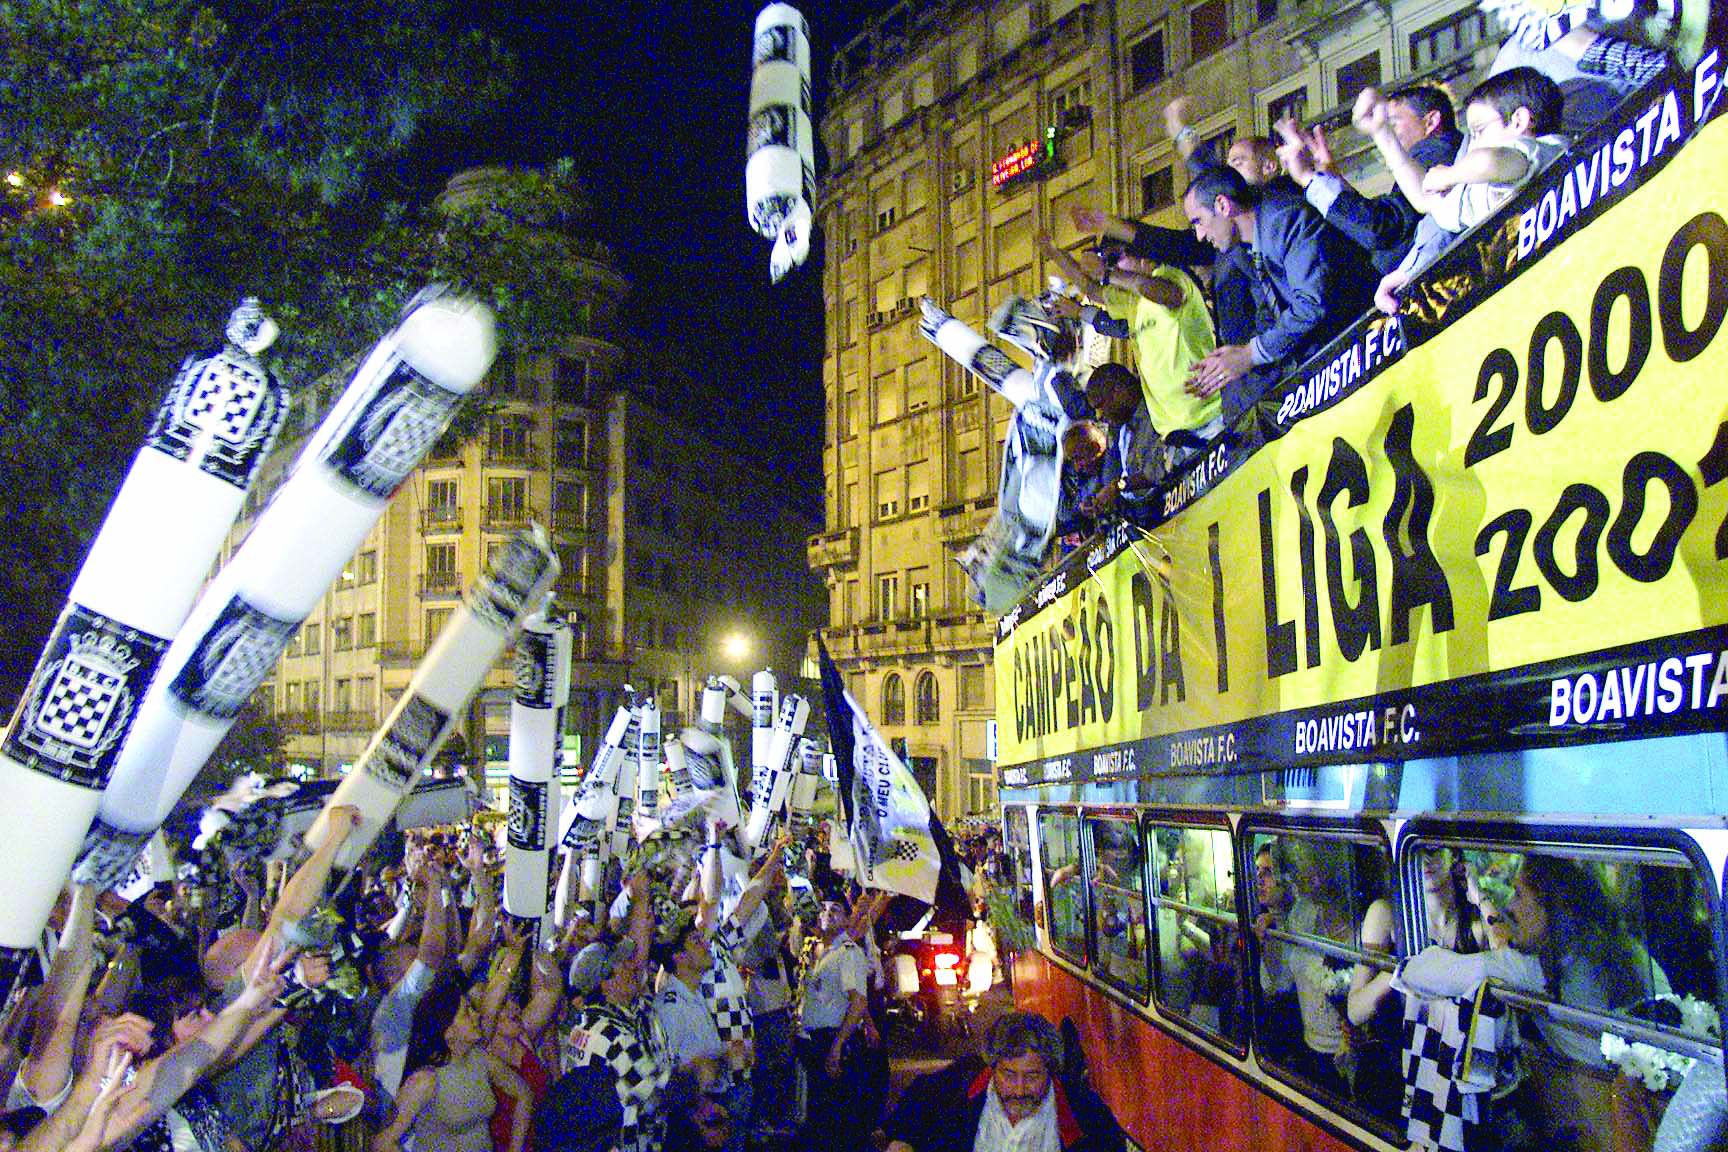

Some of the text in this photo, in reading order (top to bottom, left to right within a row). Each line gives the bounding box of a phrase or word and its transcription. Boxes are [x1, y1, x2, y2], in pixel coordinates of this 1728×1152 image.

[1517, 88, 1680, 261] BOAVISTA
[1464, 211, 1728, 470] 2000
[1276, 343, 1361, 425] BOAVISTA
[1163, 443, 1228, 517] BOAVISTA F.C.
[1131, 569, 1186, 712] DA
[1258, 402, 1455, 680] LIGA
[1549, 649, 1728, 727] BOAVISTA
[1170, 732, 1238, 767] BOAVISTA F.C.
[1295, 703, 1420, 754] BOAVISTA F.C.
